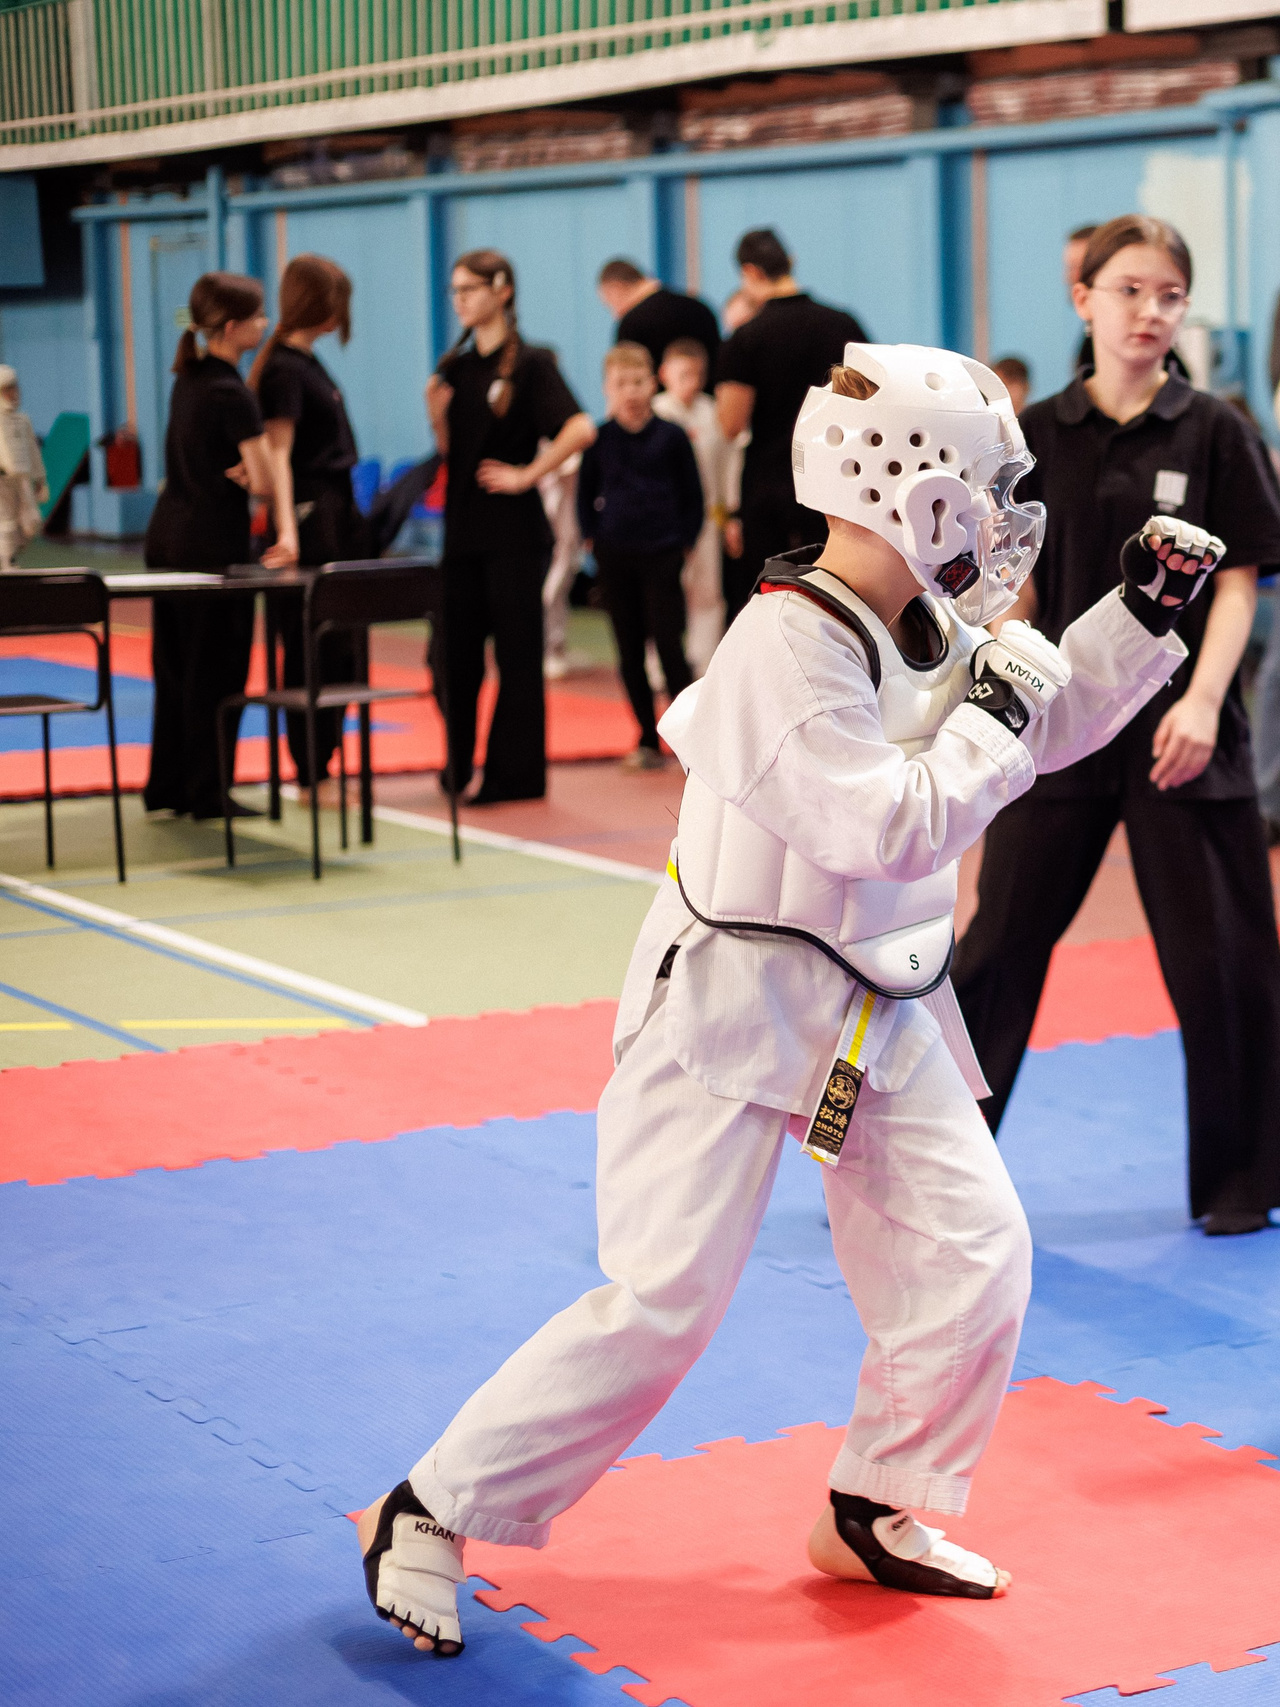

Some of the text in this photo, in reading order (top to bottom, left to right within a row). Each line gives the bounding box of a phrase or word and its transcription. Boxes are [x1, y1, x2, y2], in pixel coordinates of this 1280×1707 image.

[1005, 661, 1044, 693] KHAN
[909, 954, 919, 970] S
[414, 1521, 456, 1543] KHAN
